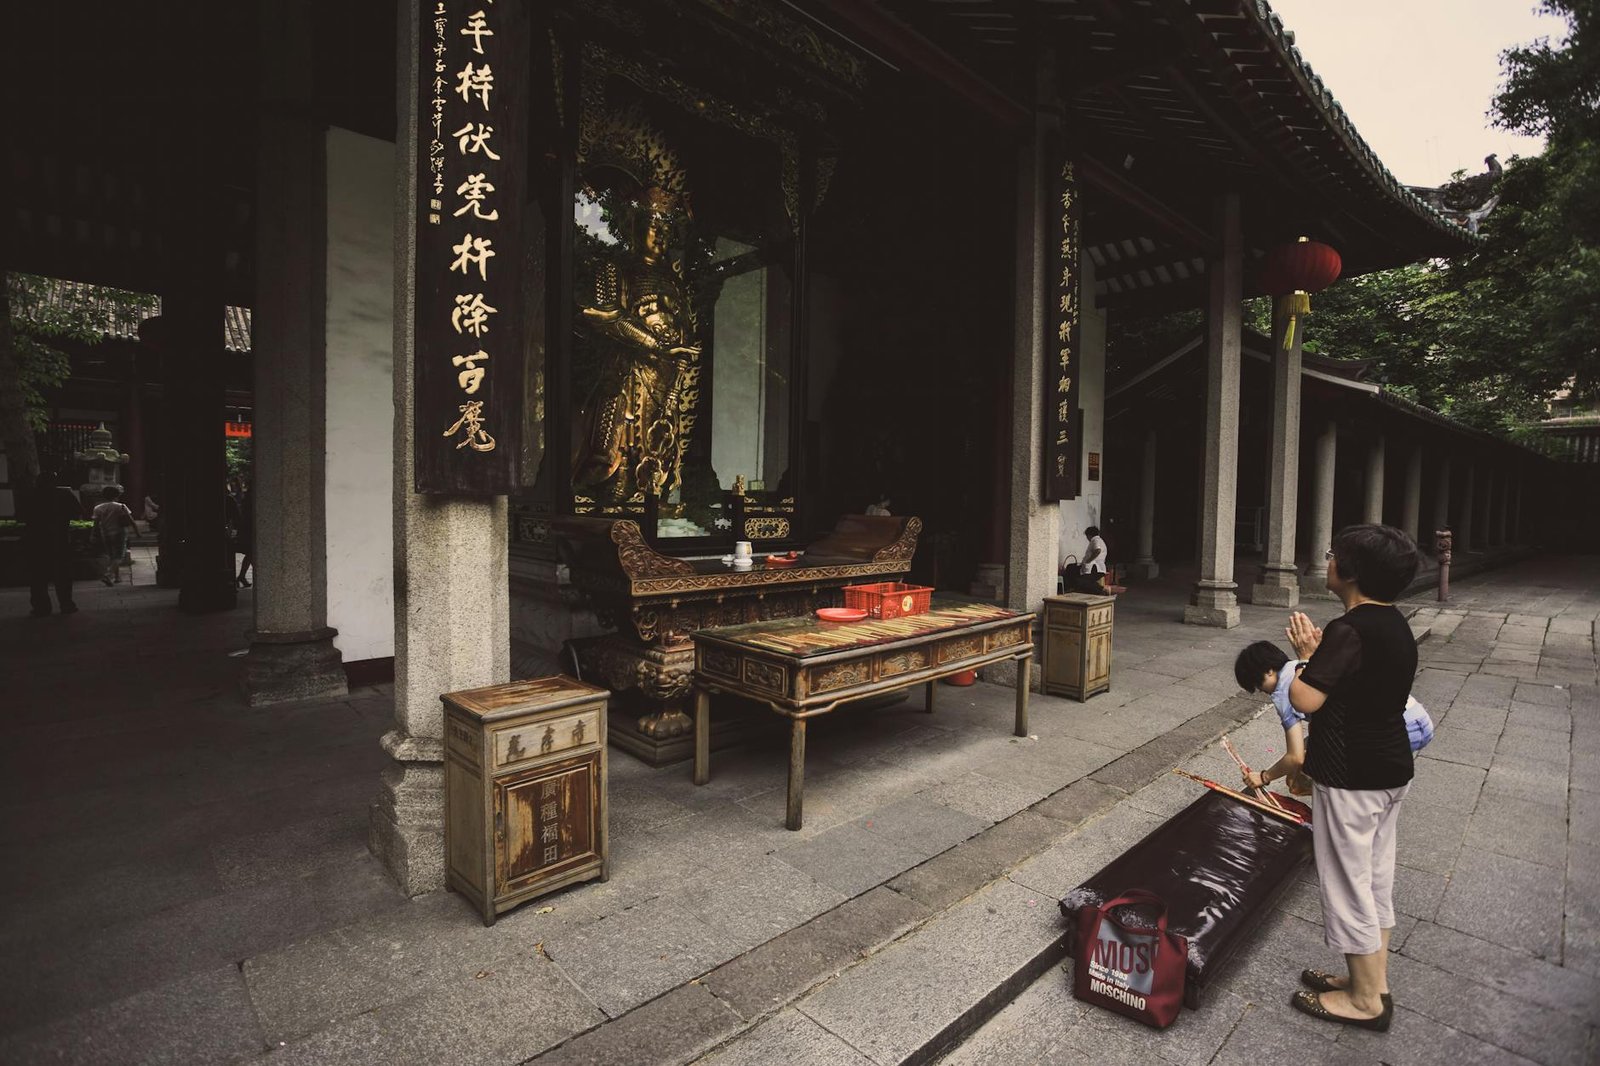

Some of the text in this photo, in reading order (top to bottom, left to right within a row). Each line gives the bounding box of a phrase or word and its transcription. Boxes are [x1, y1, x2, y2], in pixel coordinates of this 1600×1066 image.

[1090, 961, 1109, 973] Since
[1088, 968, 1106, 980] Made
[1115, 979, 1130, 991] Italy
[1090, 978, 1146, 1011] MOSCHINO
